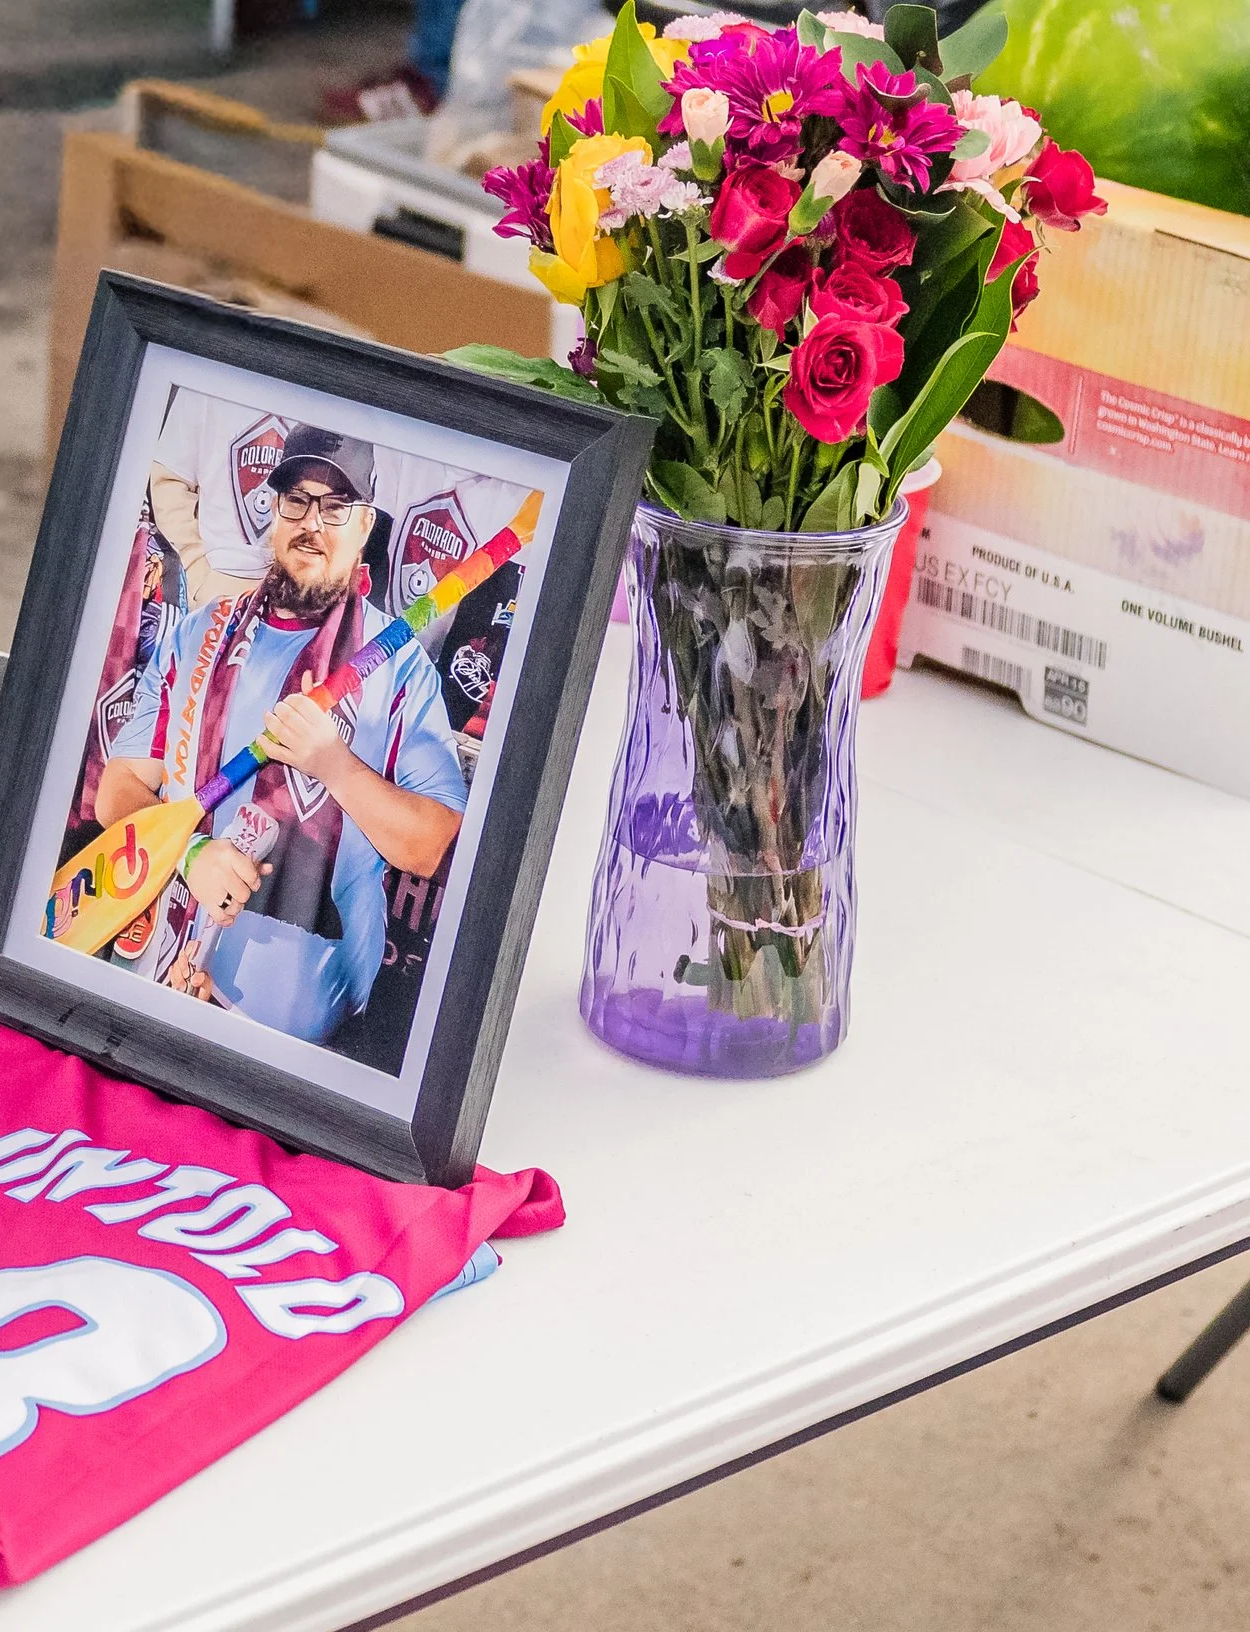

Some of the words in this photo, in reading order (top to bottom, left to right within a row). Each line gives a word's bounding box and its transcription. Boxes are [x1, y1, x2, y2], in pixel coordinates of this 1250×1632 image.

[972, 545, 1020, 575] PRODUCE
[1024, 563, 1037, 578] OF
[1121, 599, 1143, 618] ONE
[1147, 607, 1195, 636] VOLUME
[1198, 626, 1244, 654] BUSHEL
